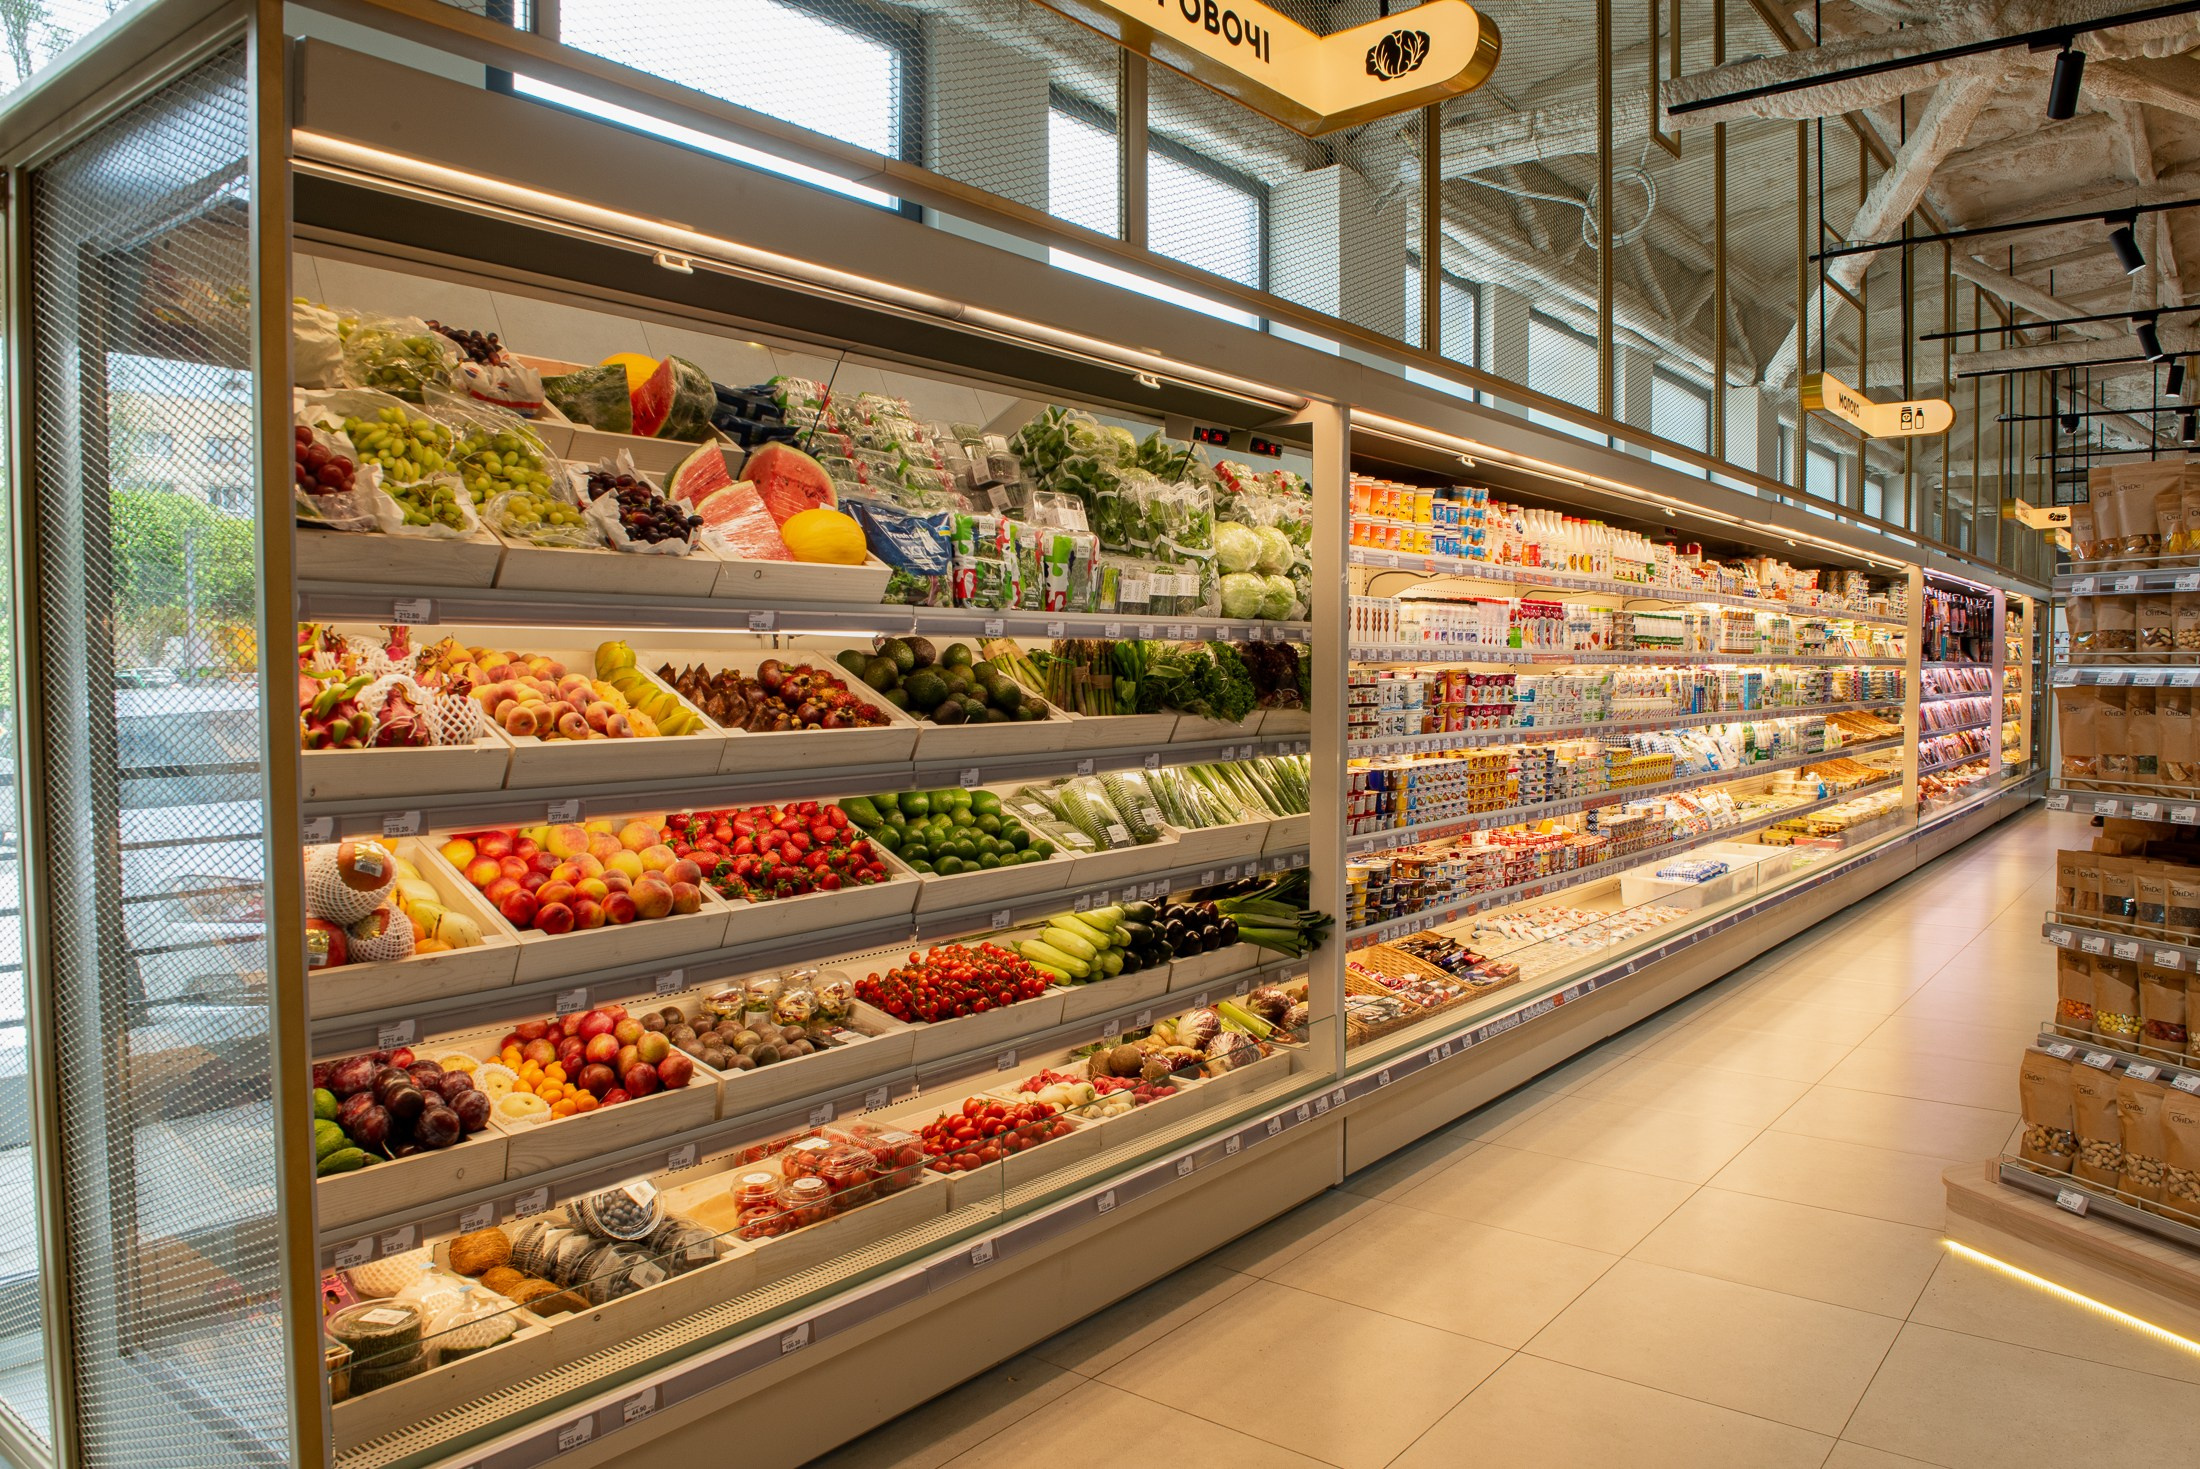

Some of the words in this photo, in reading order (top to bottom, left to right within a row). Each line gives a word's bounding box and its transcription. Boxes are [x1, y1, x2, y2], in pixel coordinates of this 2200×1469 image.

[1180, 0, 1270, 64] ОВОЧІ
[1838, 392, 1860, 418] МОЛОКО
[560, 1003, 578, 1011] 377.60
[383, 1035, 404, 1045] 271.40
[523, 1203, 538, 1213] 85.50
[386, 1242, 404, 1252] 88.20
[344, 1254, 362, 1266] 85.50
[632, 1404, 647, 1416] 44.90
[564, 1434, 583, 1447] 153.40
